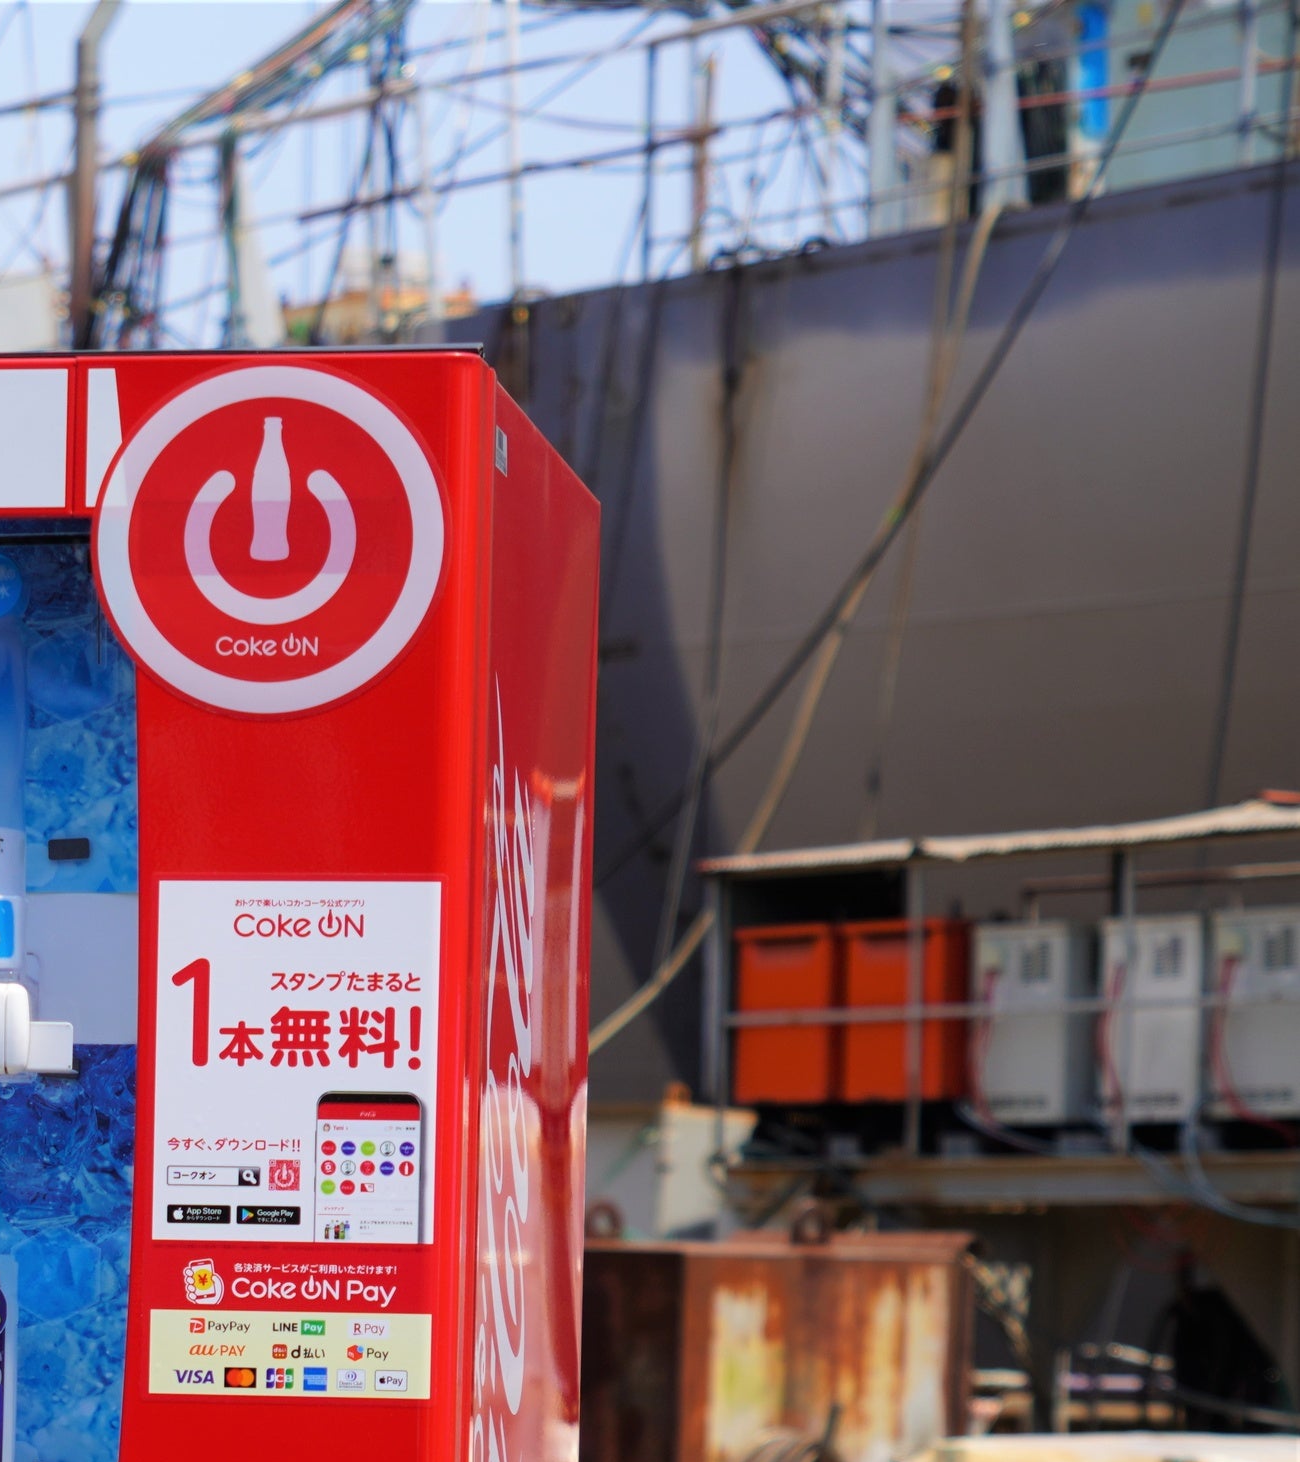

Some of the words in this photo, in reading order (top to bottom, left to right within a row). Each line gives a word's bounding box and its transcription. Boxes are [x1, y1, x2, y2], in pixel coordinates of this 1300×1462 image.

[216, 636, 276, 656] Coke
[235, 899, 365, 907] おトクで楽しいコカ・コーラ公式アプリ
[234, 913, 311, 938] Coke
[271, 971, 421, 992] スタンプたまると
[172, 1170, 216, 1180] コークオン
[257, 1209, 279, 1217] Google
[231, 1277, 296, 1299] Coke
[347, 1283, 396, 1308] Pay
[208, 1321, 250, 1333] PayPay
[273, 1323, 297, 1332] LINE
[304, 1323, 322, 1333] Pay
[364, 1324, 384, 1334] Pay
[221, 1345, 245, 1356] PAY
[367, 1348, 388, 1360] Pay
[173, 1370, 214, 1384] VISA
[266, 1368, 294, 1388] JCB
[387, 1376, 403, 1386] Pay
